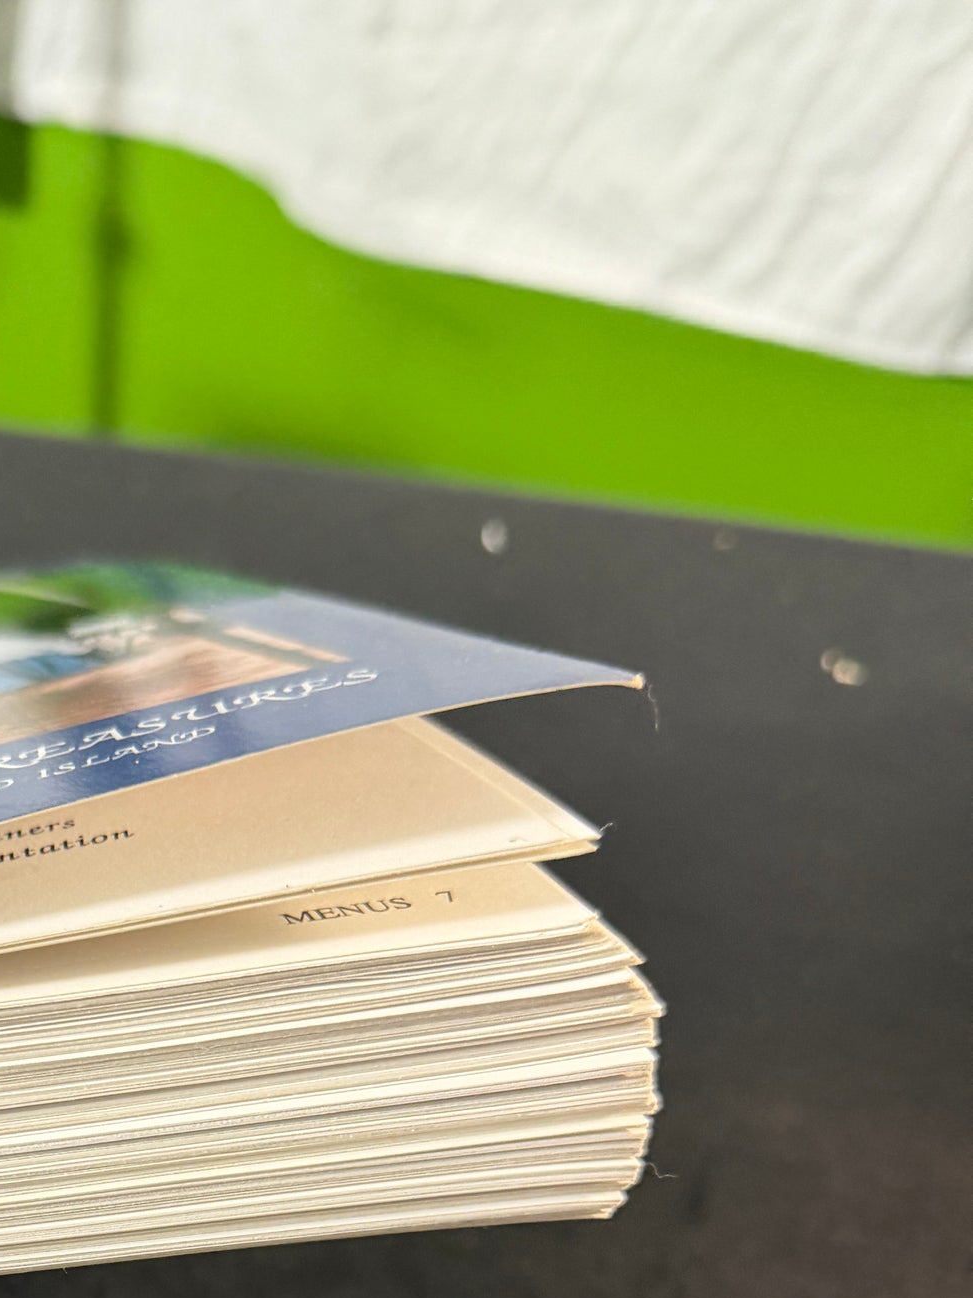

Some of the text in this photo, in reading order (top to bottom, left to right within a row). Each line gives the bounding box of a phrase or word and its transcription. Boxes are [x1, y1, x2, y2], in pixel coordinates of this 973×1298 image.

[37, 726, 215, 779] ISLAND
[280, 890, 454, 925] MENUS 7
